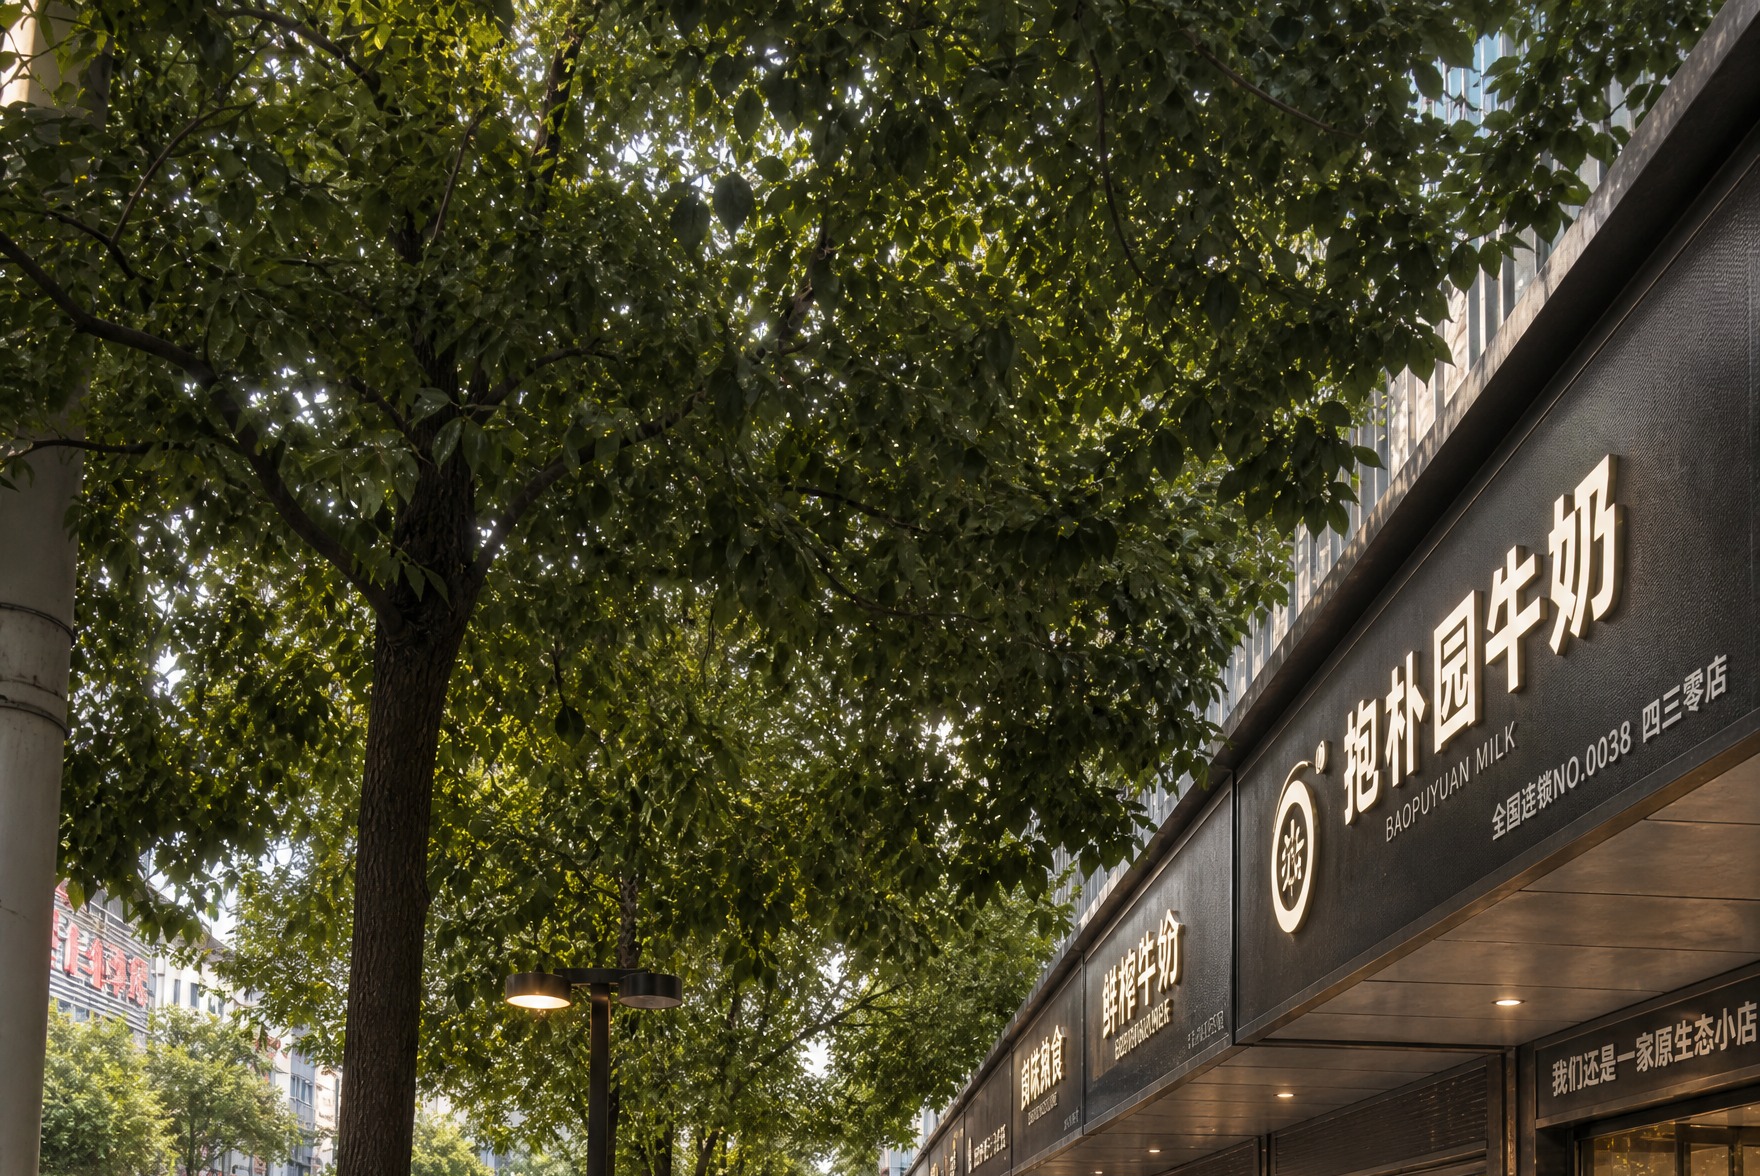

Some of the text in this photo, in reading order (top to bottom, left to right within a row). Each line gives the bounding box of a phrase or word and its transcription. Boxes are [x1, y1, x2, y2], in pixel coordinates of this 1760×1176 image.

[1343, 453, 1622, 826] 抱朴园牛奶
[1386, 721, 1515, 842] BAOPUYUAN MILK
[1492, 654, 1728, 841] 全国连锁NO.0038 四三零店
[1552, 1000, 1758, 1097] 我们还是一家原生态小店
